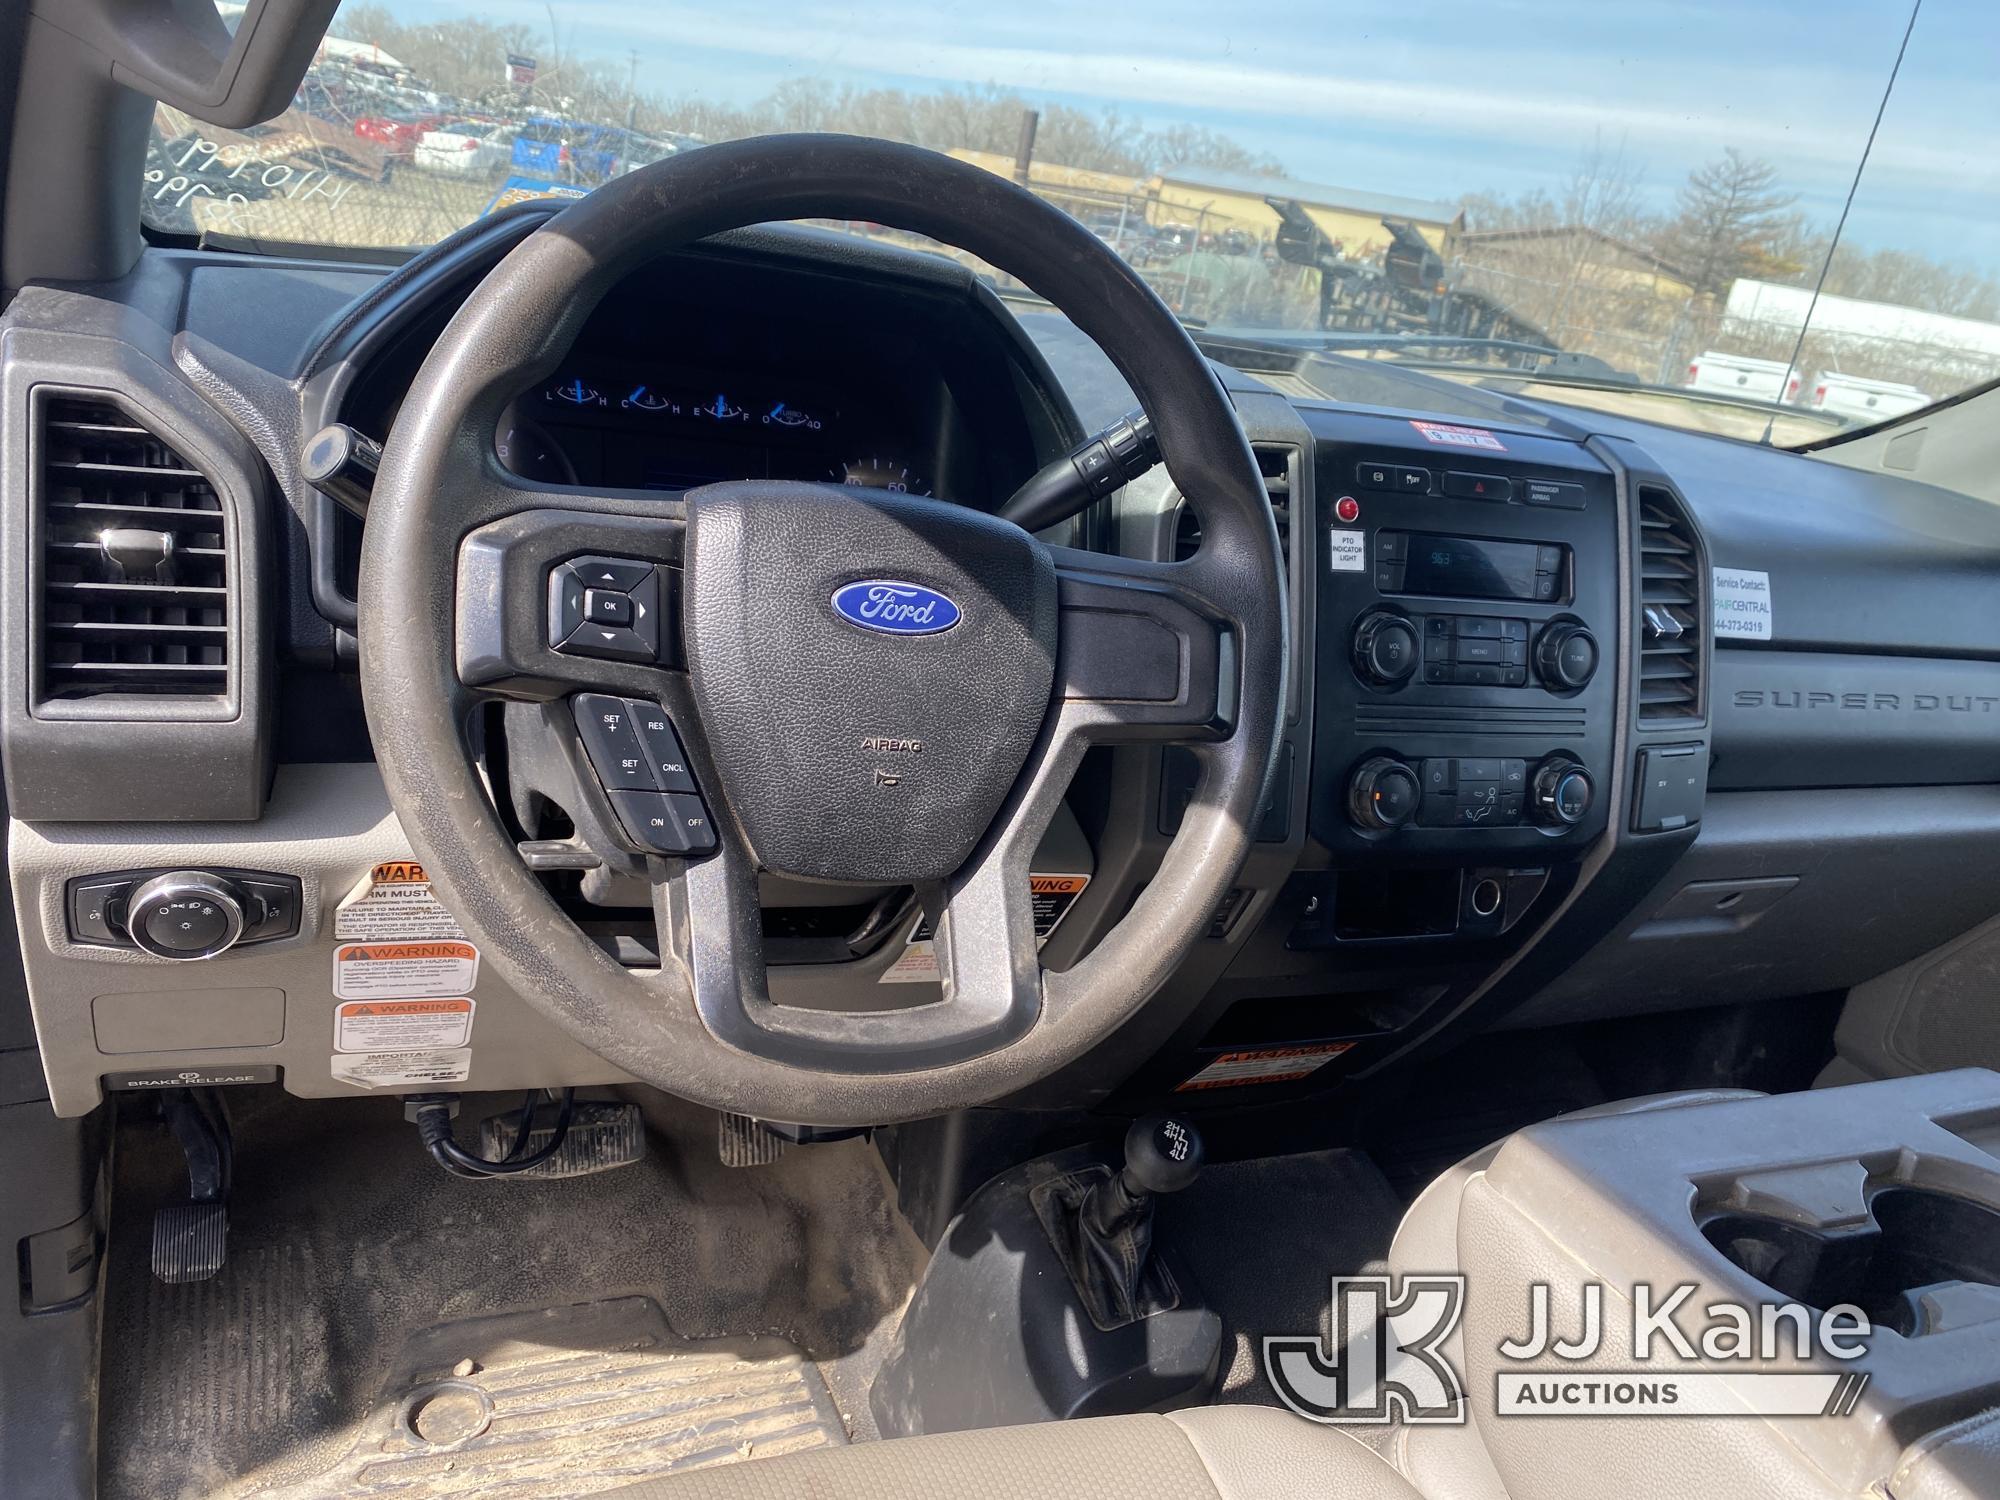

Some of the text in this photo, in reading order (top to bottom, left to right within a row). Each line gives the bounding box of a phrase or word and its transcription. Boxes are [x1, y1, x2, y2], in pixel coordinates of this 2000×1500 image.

[599, 397, 606, 406] H
[673, 405, 680, 414] H
[694, 408, 700, 416] E
[744, 413, 749, 421] F
[807, 420, 821, 429] 40
[1716, 576, 1738, 589] Service
[604, 602, 616, 610] OK
[859, 586, 936, 625] Ford
[1734, 690, 1900, 710] SUPER
[604, 714, 620, 724] SET
[648, 722, 664, 731] RES
[860, 738, 922, 753] AIRBAG
[622, 760, 638, 768] SET
[662, 764, 684, 772] CNCL
[651, 818, 664, 827] ON
[688, 818, 703, 827] OFF
[375, 865, 429, 881] WAR
[373, 946, 471, 958] WARNING
[380, 1003, 458, 1012] WARNING
[128, 1074, 255, 1087] BRAKE RELEASE
[1166, 1120, 1180, 1133] 2H
[1164, 1129, 1178, 1141] 4H
[1173, 1141, 1182, 1151] N
[1169, 1149, 1181, 1161] 4L
